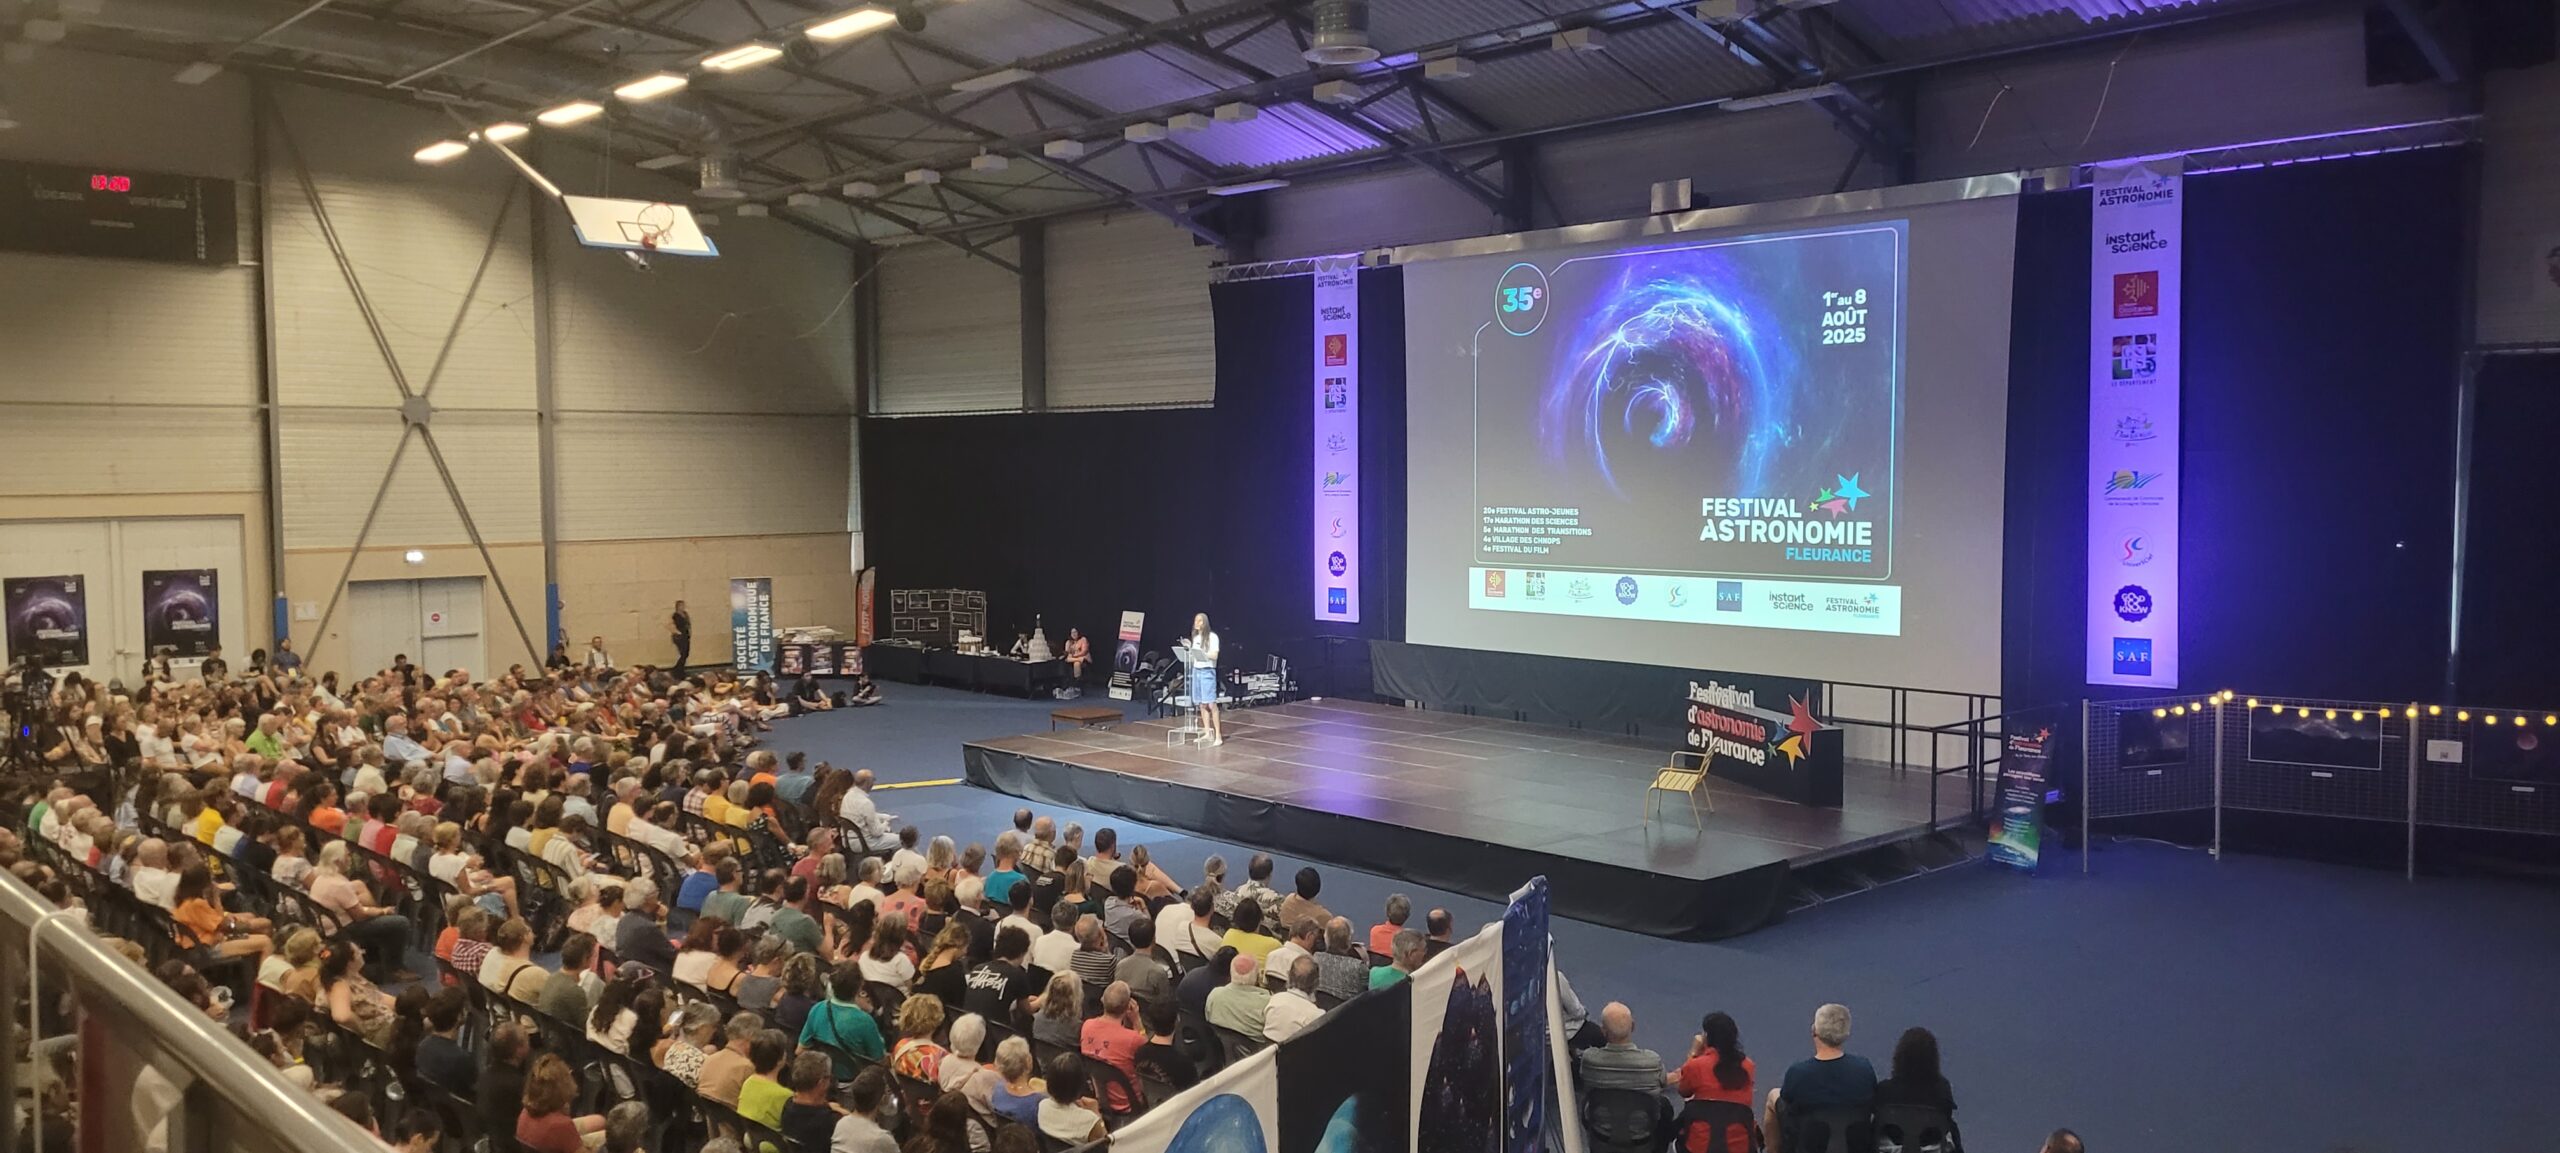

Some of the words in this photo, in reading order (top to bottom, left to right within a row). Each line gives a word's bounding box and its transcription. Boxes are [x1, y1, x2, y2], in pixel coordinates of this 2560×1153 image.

[2099, 189, 2174, 207] ASTRONOMIE
[2100, 185, 2144, 197] FESTIVAL
[1317, 278, 1353, 288] ASTRONOMIE
[1837, 296, 1853, 306] au
[1854, 288, 1867, 305] 8
[1821, 306, 1868, 328] AOÛT
[1822, 327, 1867, 345] 2025
[1496, 507, 1527, 515] FESTIVAL
[1527, 507, 1579, 516] ASTRO-JEUNES
[1702, 497, 1802, 518] FESTIVAL
[1494, 517, 1531, 525] MARATHON
[1531, 517, 1545, 526] DES
[1545, 518, 1579, 526] SCIENCES
[1493, 526, 1529, 535] MARATHON
[1531, 527, 1545, 535] DES
[1547, 527, 1593, 537] TRANSITIONS
[1700, 518, 1873, 546] ASTRONOMIE
[1492, 536, 1519, 544] VILLAGE
[1519, 537, 1532, 545] DES
[1492, 545, 1522, 554] FESTIVAL
[1523, 546, 1533, 554] DU
[1533, 546, 1550, 555] FILM
[1785, 547, 1873, 564] FLEURANCE
[1825, 597, 1858, 605] FESTIVAL
[1825, 604, 1880, 614] ASTRONOMIE
[746, 581, 759, 665] ASTRONOMIQUE
[758, 594, 770, 636] FRANCE
[733, 626, 747, 670] SOCIÉTÉ
[759, 638, 771, 653] DE
[2116, 651, 2149, 662] SAF
[1688, 705, 1765, 742] d'astronomie
[1688, 729, 1699, 746] de
[1701, 728, 1765, 766] Fleurance
